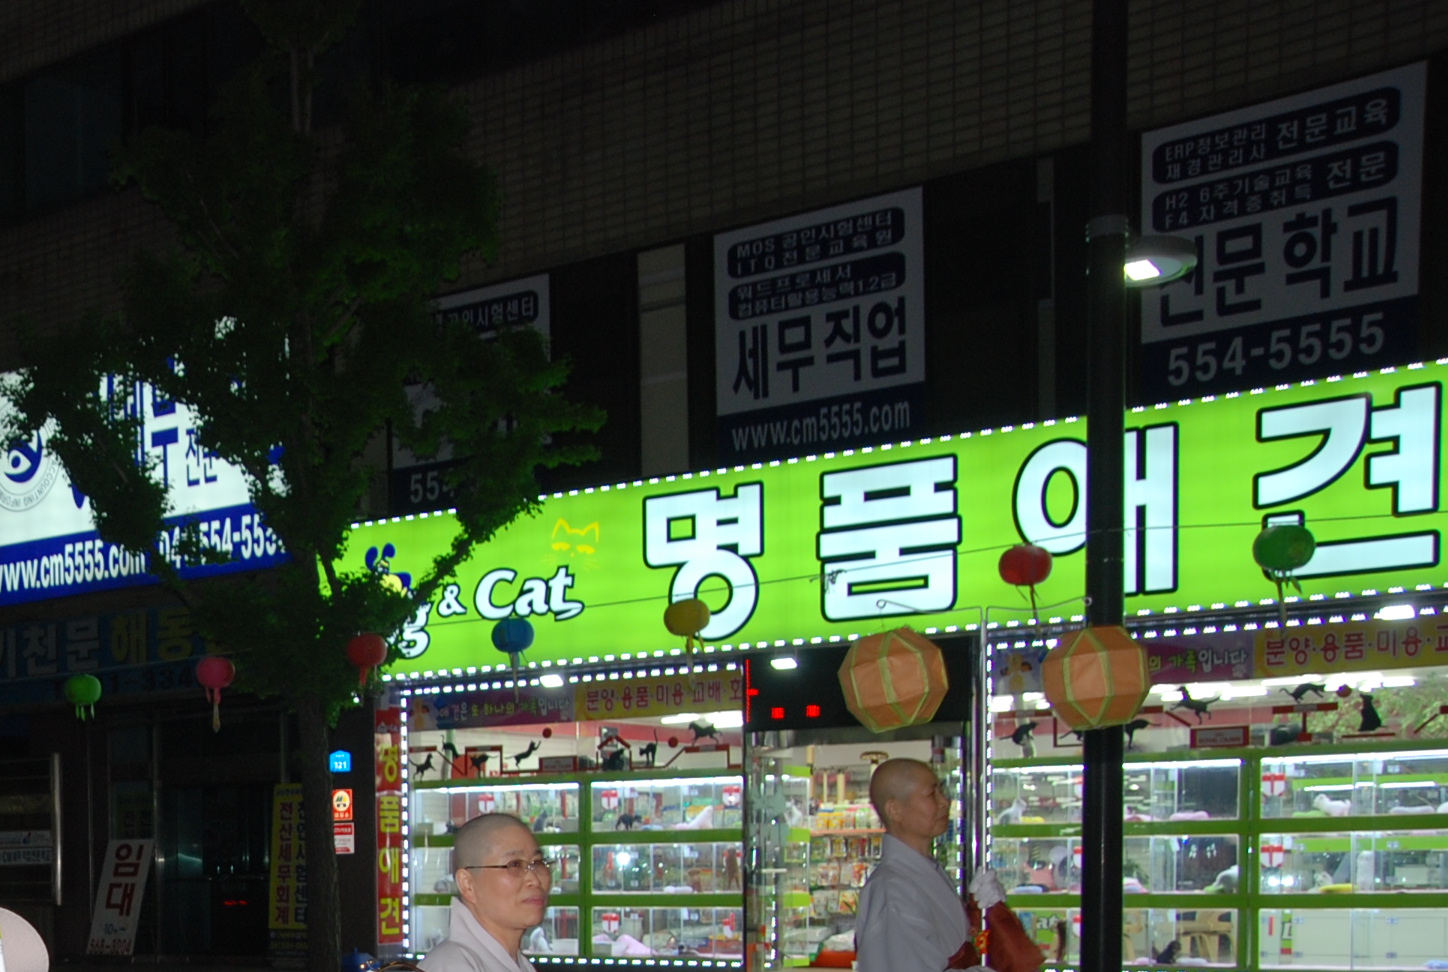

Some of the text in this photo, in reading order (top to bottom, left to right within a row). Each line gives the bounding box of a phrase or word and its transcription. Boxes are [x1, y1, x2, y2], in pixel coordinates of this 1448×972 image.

[1276, 97, 1389, 150] 전문교육
[1165, 191, 1188, 211] H2
[1326, 151, 1386, 190] 전문
[737, 210, 892, 260] MOS 공인시험센터
[782, 228, 892, 267] 전문교육원
[1165, 211, 1189, 230] F4
[737, 264, 851, 300] 워드프로세서
[732, 296, 907, 400] 세무직업
[1167, 312, 1386, 387] 554-5555
[732, 400, 911, 453] www.cm5555.com
[643, 381, 1442, 641] 명품애견
[436, 565, 585, 621] & Cat
[378, 744, 401, 937] 명품애견
[105, 843, 145, 917] 임대
